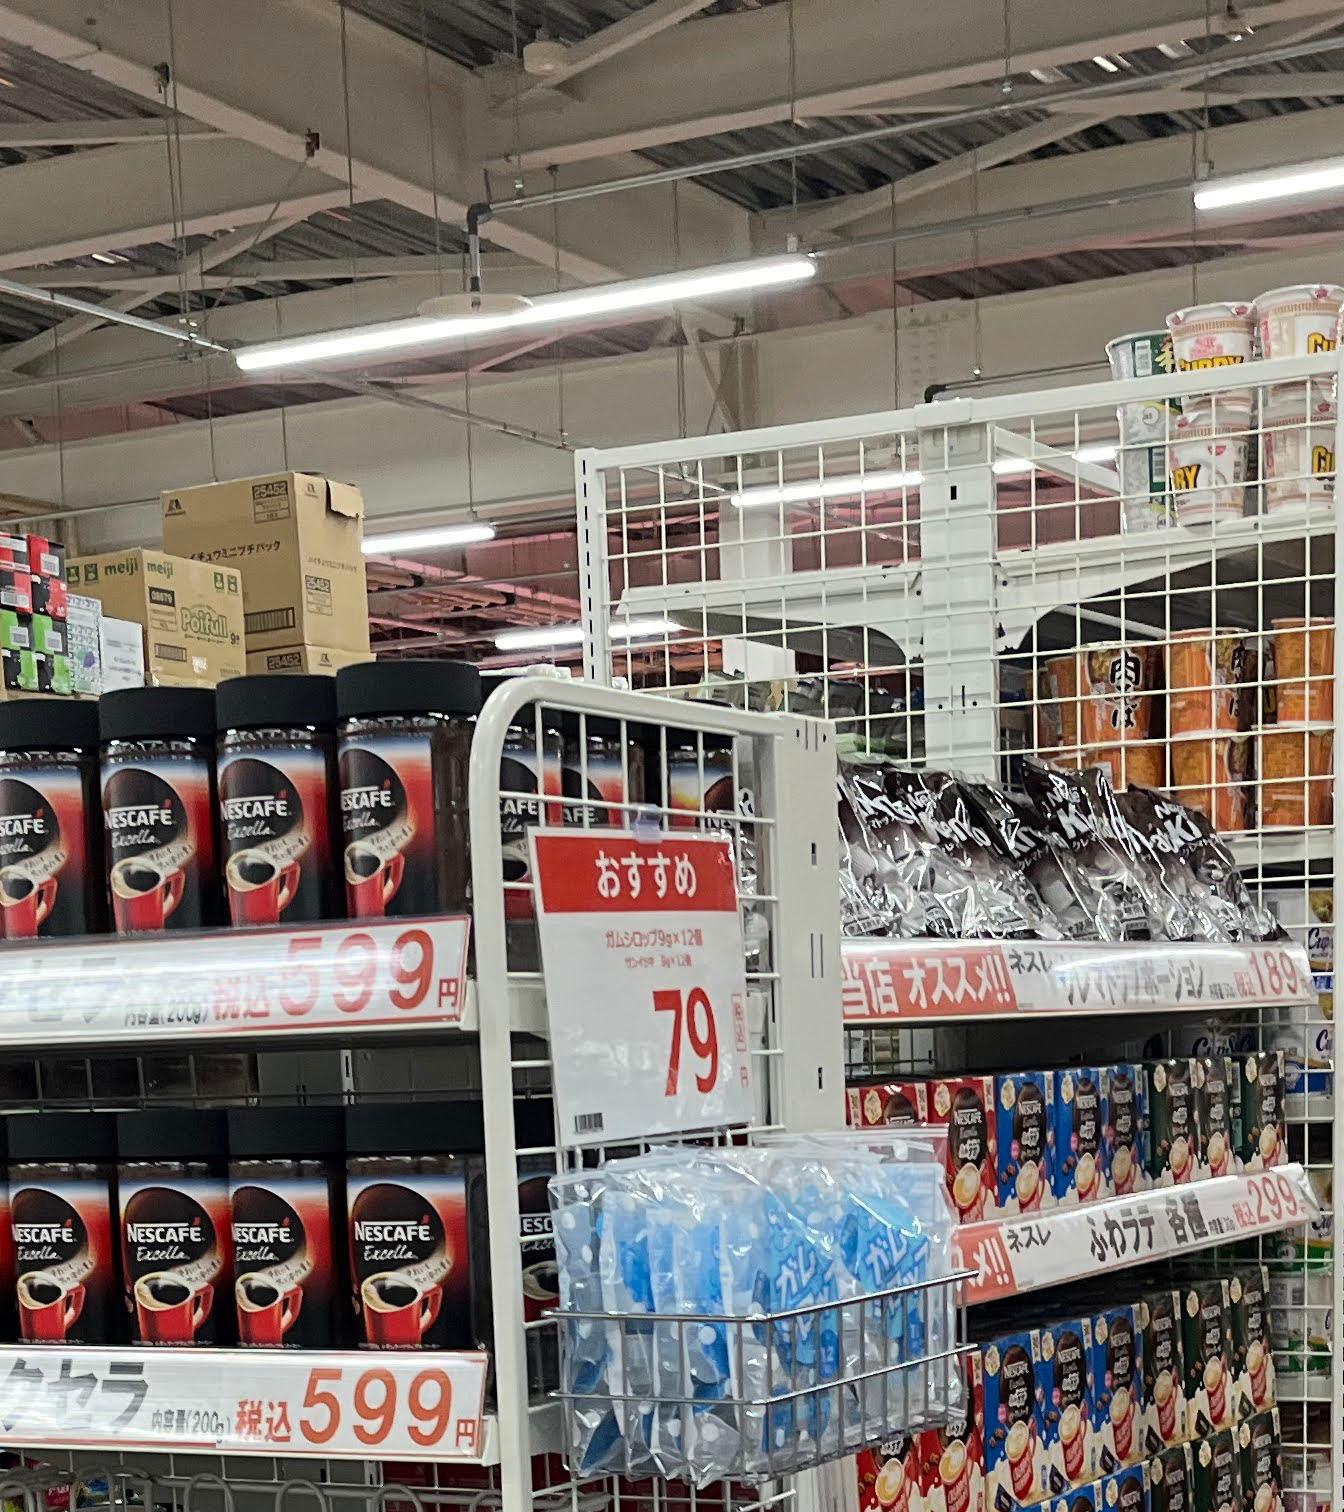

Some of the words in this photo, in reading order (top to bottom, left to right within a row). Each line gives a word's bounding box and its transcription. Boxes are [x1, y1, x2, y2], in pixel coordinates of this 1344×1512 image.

[104, 559, 139, 577] meiji
[146, 560, 175, 580] meiji
[180, 603, 229, 639] Poifull
[593, 850, 698, 901] おすすめ
[277, 928, 437, 1019] 599
[437, 976, 459, 1009] 円
[1247, 949, 1300, 997] 189
[652, 985, 719, 1099] 79
[1008, 1221, 1052, 1254] ネスレ
[1090, 1206, 1156, 1264] ふわラテ
[1246, 1176, 1300, 1224] 299
[234, 1398, 293, 1446] 税込
[300, 1367, 455, 1448] 599
[455, 1418, 478, 1450] 円
